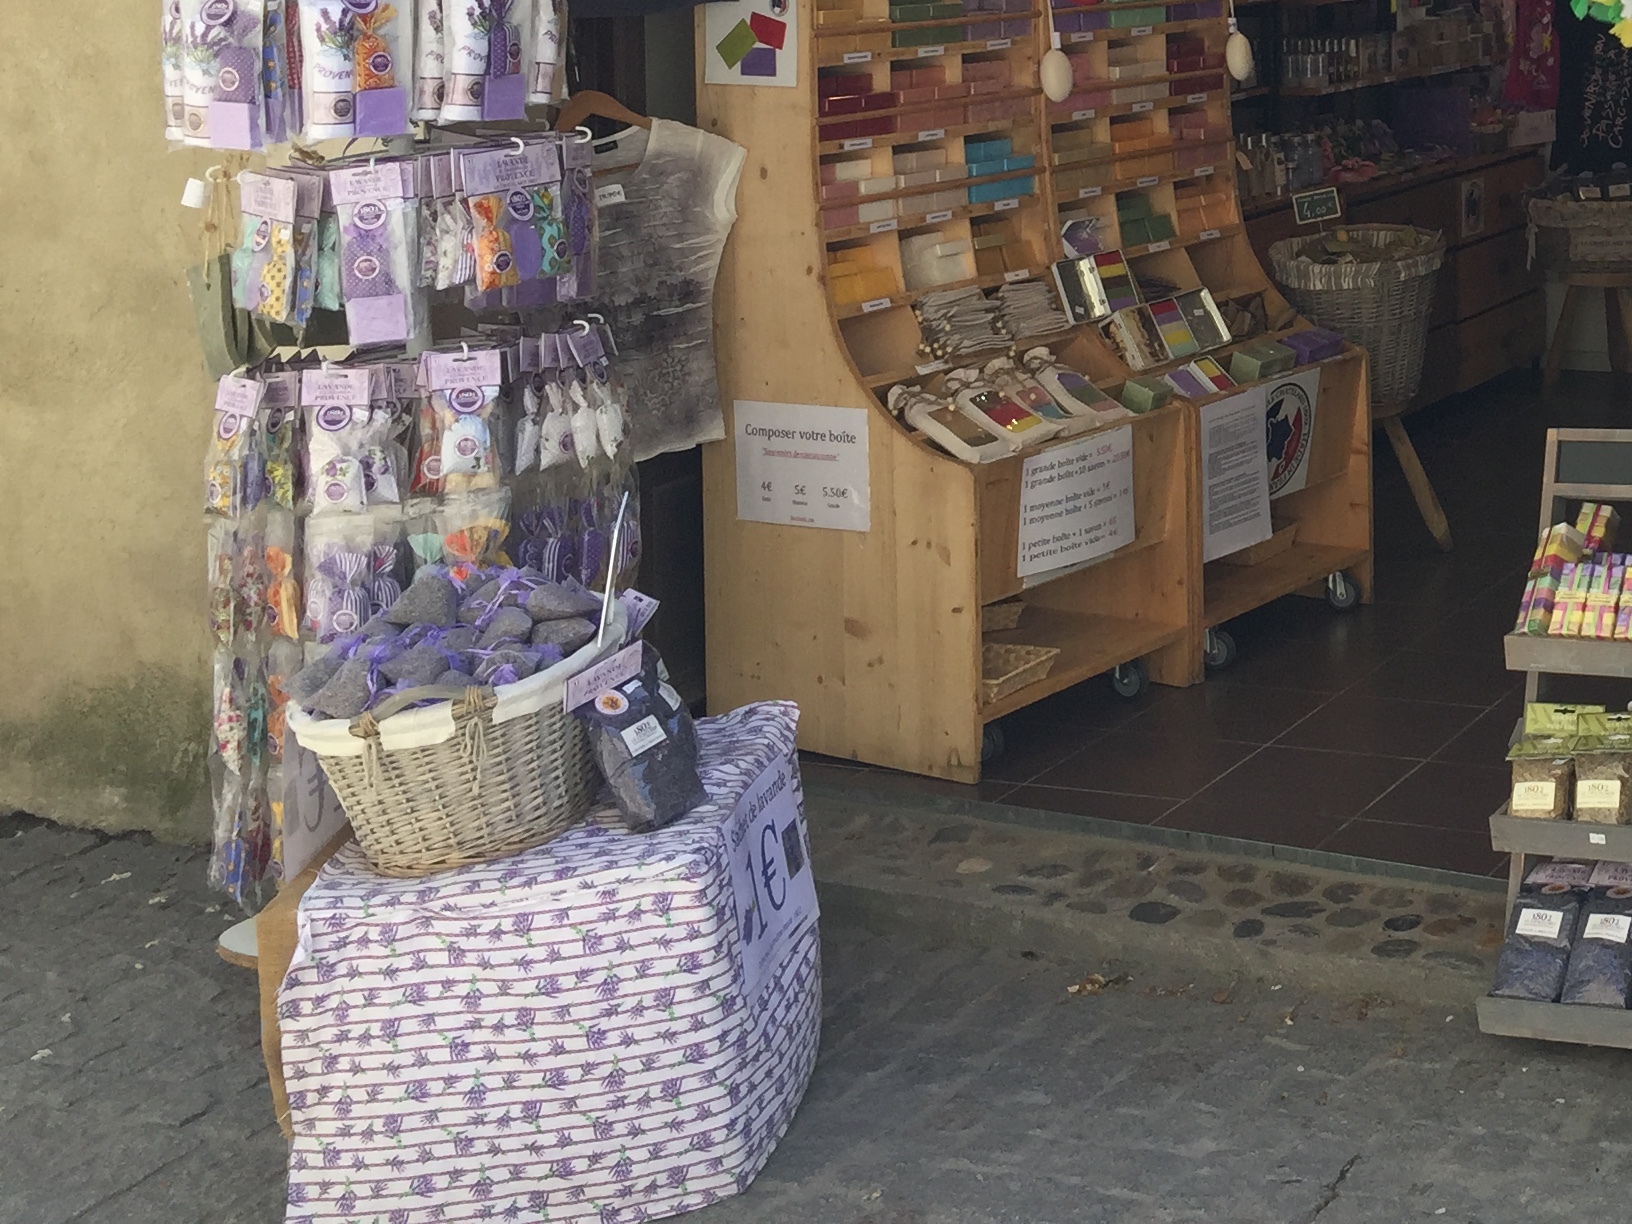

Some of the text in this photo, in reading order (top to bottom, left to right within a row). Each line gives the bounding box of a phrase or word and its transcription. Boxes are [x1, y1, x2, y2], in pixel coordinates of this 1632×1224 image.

[745, 424, 856, 444] Composer votre boîte
[761, 481, 772, 491] 4€
[795, 485, 806, 495] 5€
